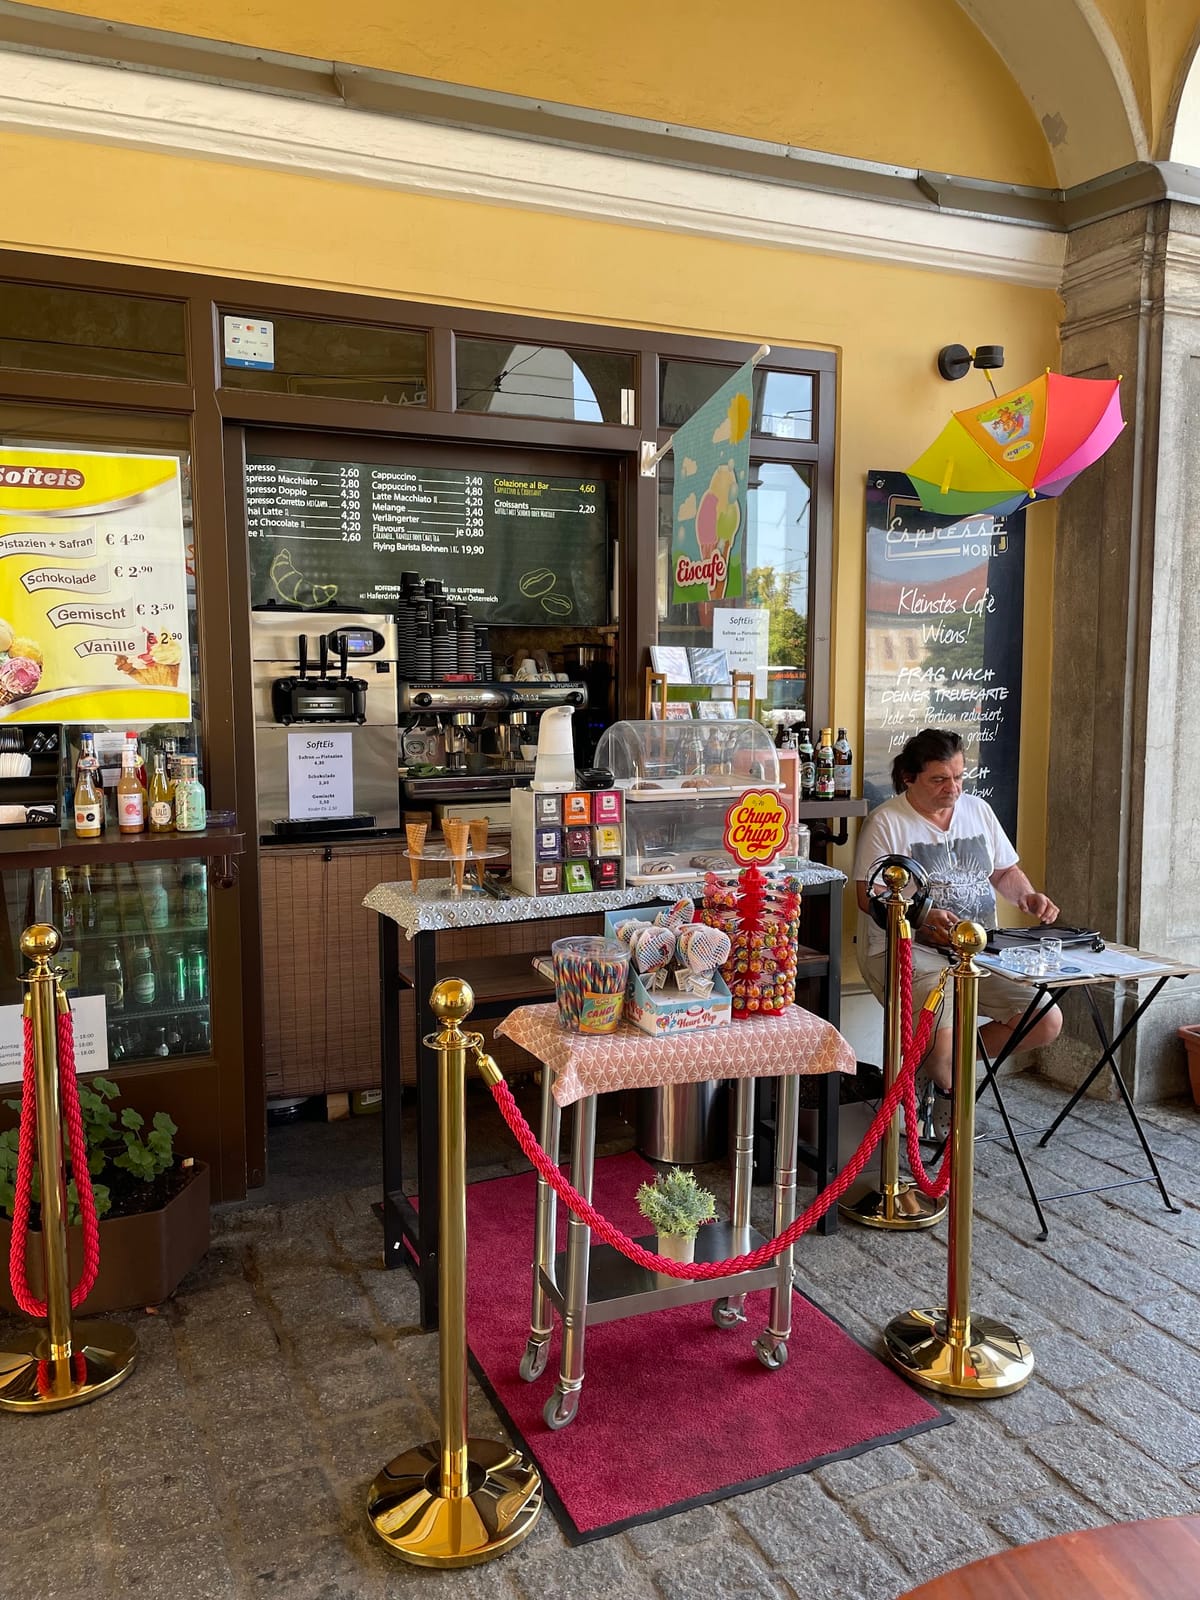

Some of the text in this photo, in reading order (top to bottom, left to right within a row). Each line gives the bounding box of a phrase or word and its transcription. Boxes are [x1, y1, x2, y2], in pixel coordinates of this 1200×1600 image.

[245, 464, 360, 478] spresso 2,60
[371, 470, 483, 486] Cappuccino 3,40
[245, 475, 360, 489] spresso Macchiato 2,80
[371, 481, 417, 492] Cappuccino
[465, 487, 483, 496] 4,80
[494, 479, 528, 488] Colazione
[529, 481, 537, 489] al
[537, 482, 549, 490] Bar
[245, 486, 360, 500] spresso Doppio 4,30
[372, 492, 392, 501] Latte
[393, 493, 432, 503] Macchiato
[465, 497, 483, 507] 4,20
[246, 497, 276, 507] spresso
[276, 496, 306, 507] Corretto
[341, 500, 361, 511] 4,90
[372, 503, 483, 517] Melange 3,40
[494, 500, 529, 509] Croissants
[247, 507, 261, 515] hai
[262, 507, 284, 516] Latte
[341, 511, 361, 521] 4,20
[372, 513, 484, 528] Verlängerter 2,90
[260, 518, 300, 529] Chocolate
[341, 522, 361, 532] 4,20
[372, 524, 484, 538] Flavours je 0,80
[60, 537, 93, 549] Safran
[106, 533, 115, 546] €
[342, 532, 362, 543] 2,60
[373, 542, 396, 553] Flying
[396, 543, 420, 552] Barista
[421, 544, 448, 553] Bohnen
[461, 545, 485, 556] 19,90
[962, 544, 999, 557] MOBIL
[27, 571, 97, 586] Schokolade
[114, 566, 123, 578] €
[677, 553, 724, 586] Eiscafe
[898, 586, 957, 615] Kleinstes
[57, 608, 126, 621] Gemischt
[136, 604, 146, 616] €
[729, 617, 754, 626] SoftEis
[922, 616, 973, 645] Wiens!
[83, 640, 136, 653] Vanille
[896, 666, 996, 685] FRAG NACH
[880, 687, 1010, 704] DEINER TREUEKARTE
[880, 707, 905, 729] Jede
[924, 706, 957, 724] Portion
[966, 722, 1000, 751] gratis!
[306, 740, 335, 750] SoftEis
[737, 807, 783, 829] Chupa
[732, 824, 779, 850] Chups
[677, 1017, 702, 1028] Heart
[702, 1012, 718, 1025] Pop
